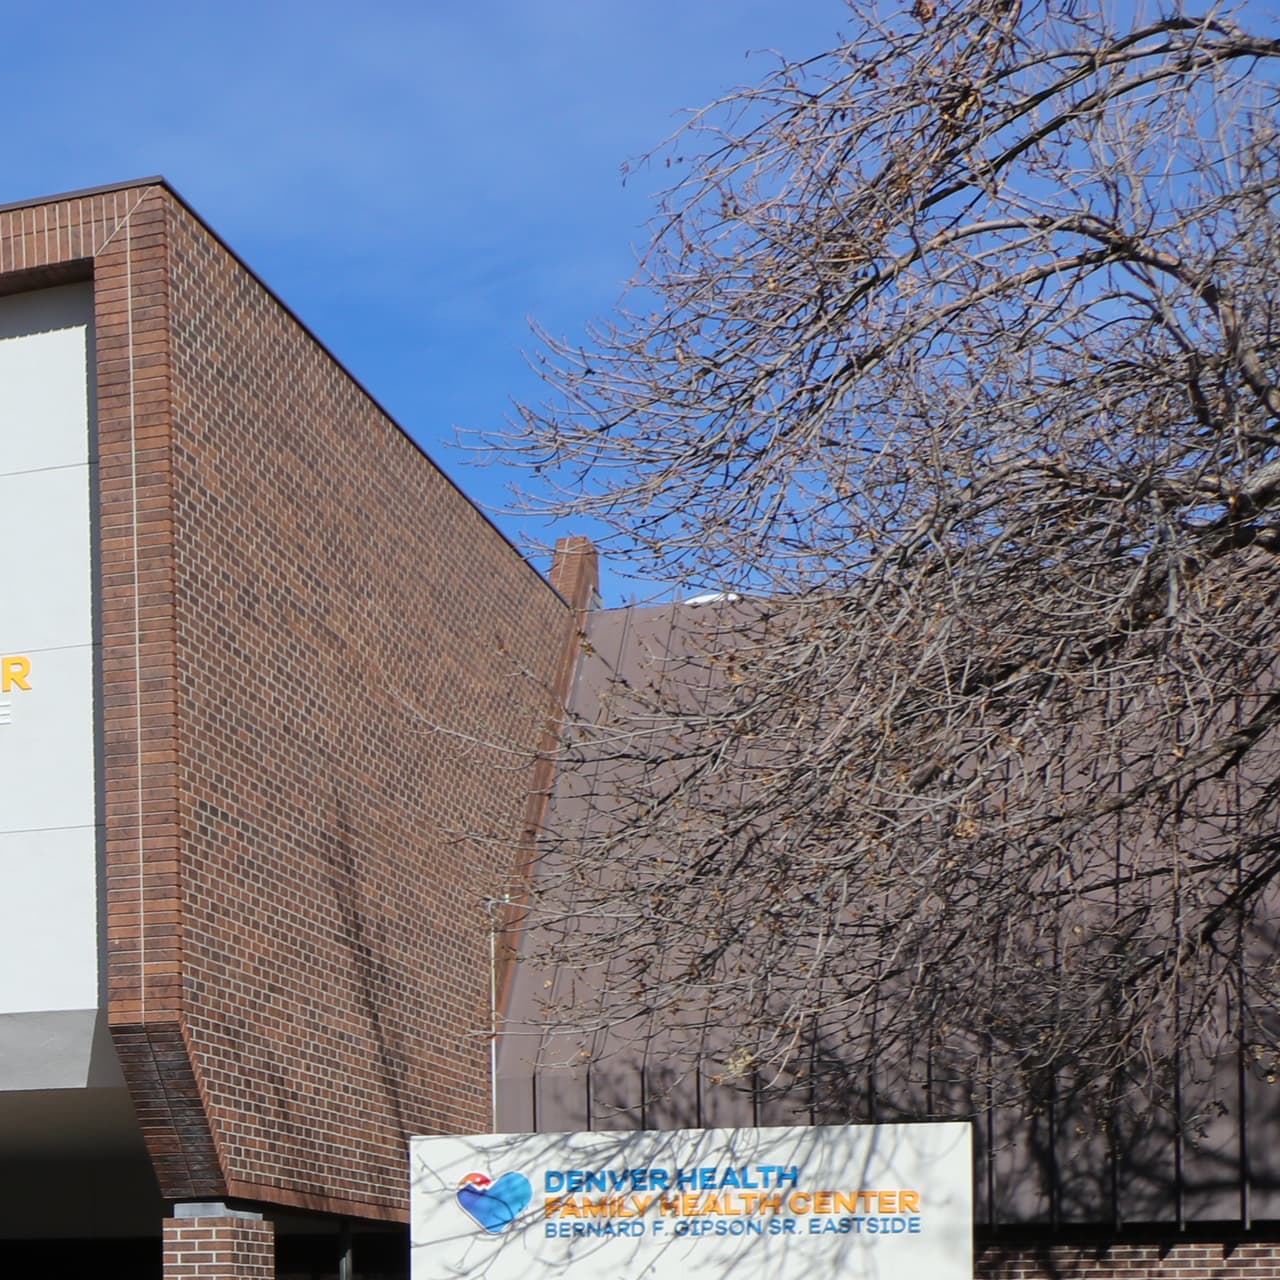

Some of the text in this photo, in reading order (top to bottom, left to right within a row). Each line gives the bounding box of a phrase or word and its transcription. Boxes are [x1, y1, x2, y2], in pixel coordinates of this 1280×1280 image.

[545, 1165, 798, 1192] DENVER HEALTH
[545, 1190, 920, 1218] FAMILY HEALTH CENTER
[545, 1217, 920, 1238] BERNARD F. GIPSON SR. EASTSIDE
